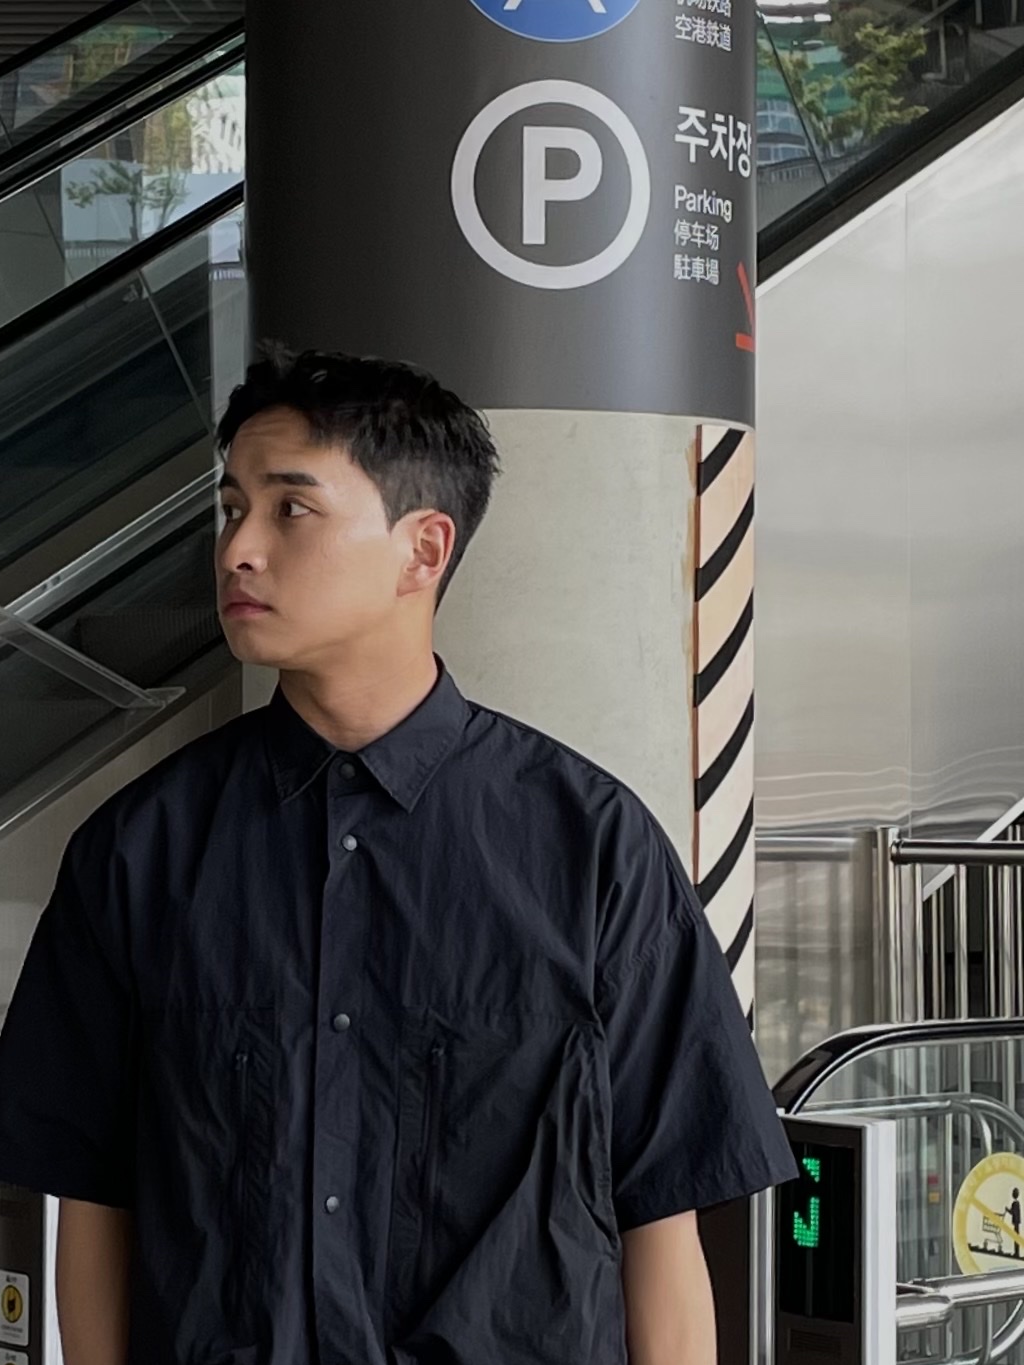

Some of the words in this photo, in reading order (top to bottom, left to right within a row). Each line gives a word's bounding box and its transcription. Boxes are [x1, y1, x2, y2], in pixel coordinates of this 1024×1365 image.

[674, 13, 732, 52] 空港鉄道
[674, 105, 753, 178] 주차장
[522, 125, 604, 245] P
[674, 184, 732, 224] Parking
[674, 218, 720, 251] 停车场
[673, 253, 720, 285] 駐車場
